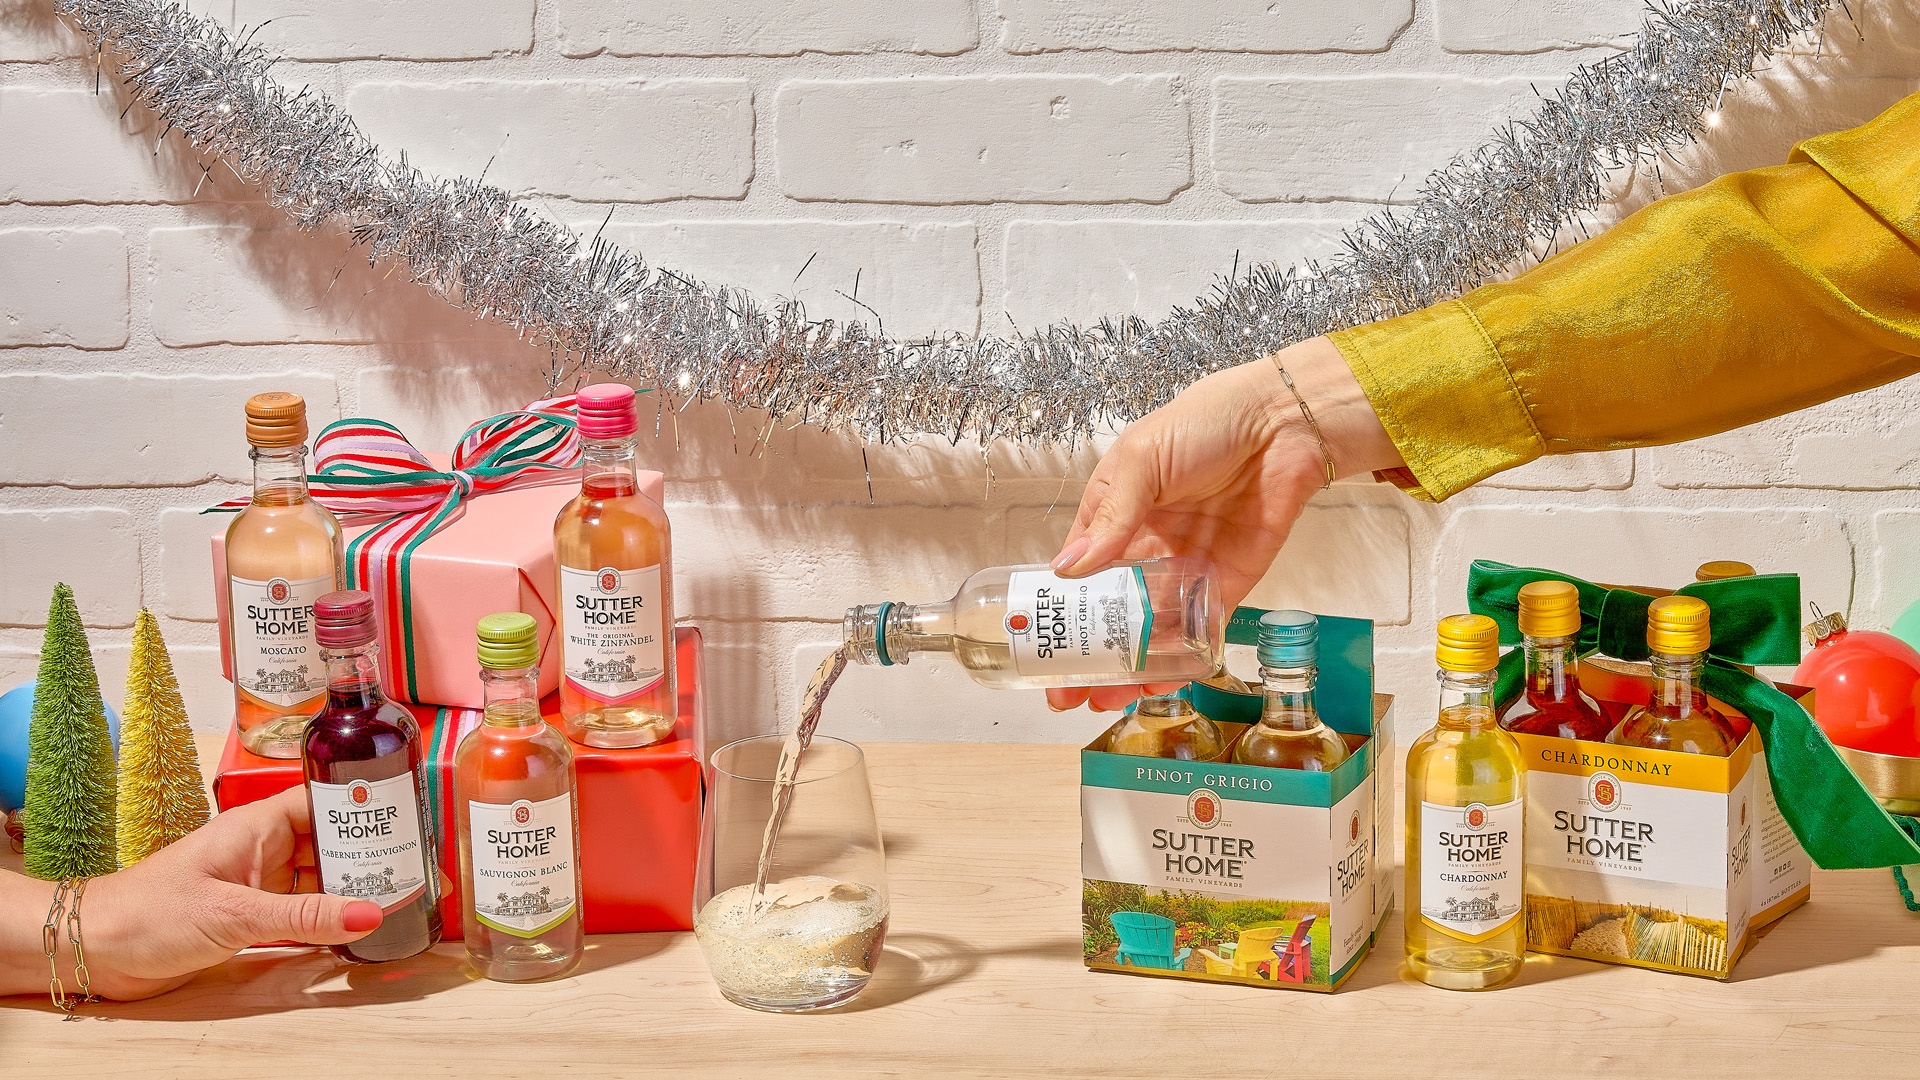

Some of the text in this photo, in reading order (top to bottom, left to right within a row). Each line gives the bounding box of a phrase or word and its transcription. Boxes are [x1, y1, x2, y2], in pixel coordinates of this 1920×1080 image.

[576, 594, 643, 611] SUTTER
[248, 605, 315, 621] SUTTER
[584, 611, 636, 625] HOME
[1052, 594, 1067, 650] HOME
[1079, 585, 1090, 656] PINOT GRIGIO
[256, 620, 308, 635] HOME
[1036, 587, 1052, 658] SUTTER
[570, 634, 654, 647] WHITE ZINFANDEL
[260, 646, 307, 655] MOSCATO
[1542, 750, 1672, 776] CHARDONNAY
[1136, 767, 1273, 792] PINOT GRIGIO
[328, 806, 398, 824] SUTTER
[338, 822, 392, 839] HOME
[487, 826, 556, 844] SUTTER
[1554, 810, 1655, 844] SUTTER
[1152, 828, 1256, 860] SUTTER
[1439, 831, 1508, 848] SUTTER
[1732, 824, 1750, 866] SUTTER
[321, 840, 418, 860] CABERNET SAUVIGNON
[497, 842, 550, 859] HOME
[1448, 846, 1502, 862] HOME
[1567, 835, 1643, 863] HOME
[1165, 853, 1244, 880] HOME
[1337, 838, 1369, 880] SUTTER
[1567, 858, 1642, 872] FAMILY VINEYARDS
[1734, 852, 1748, 883] HOME
[480, 861, 568, 878] SAUVIGNON BLANC
[1440, 871, 1508, 883] CHARDONNAY
[1166, 876, 1243, 888] FAMILY VINEYARDS
[1342, 860, 1366, 898] HOME
